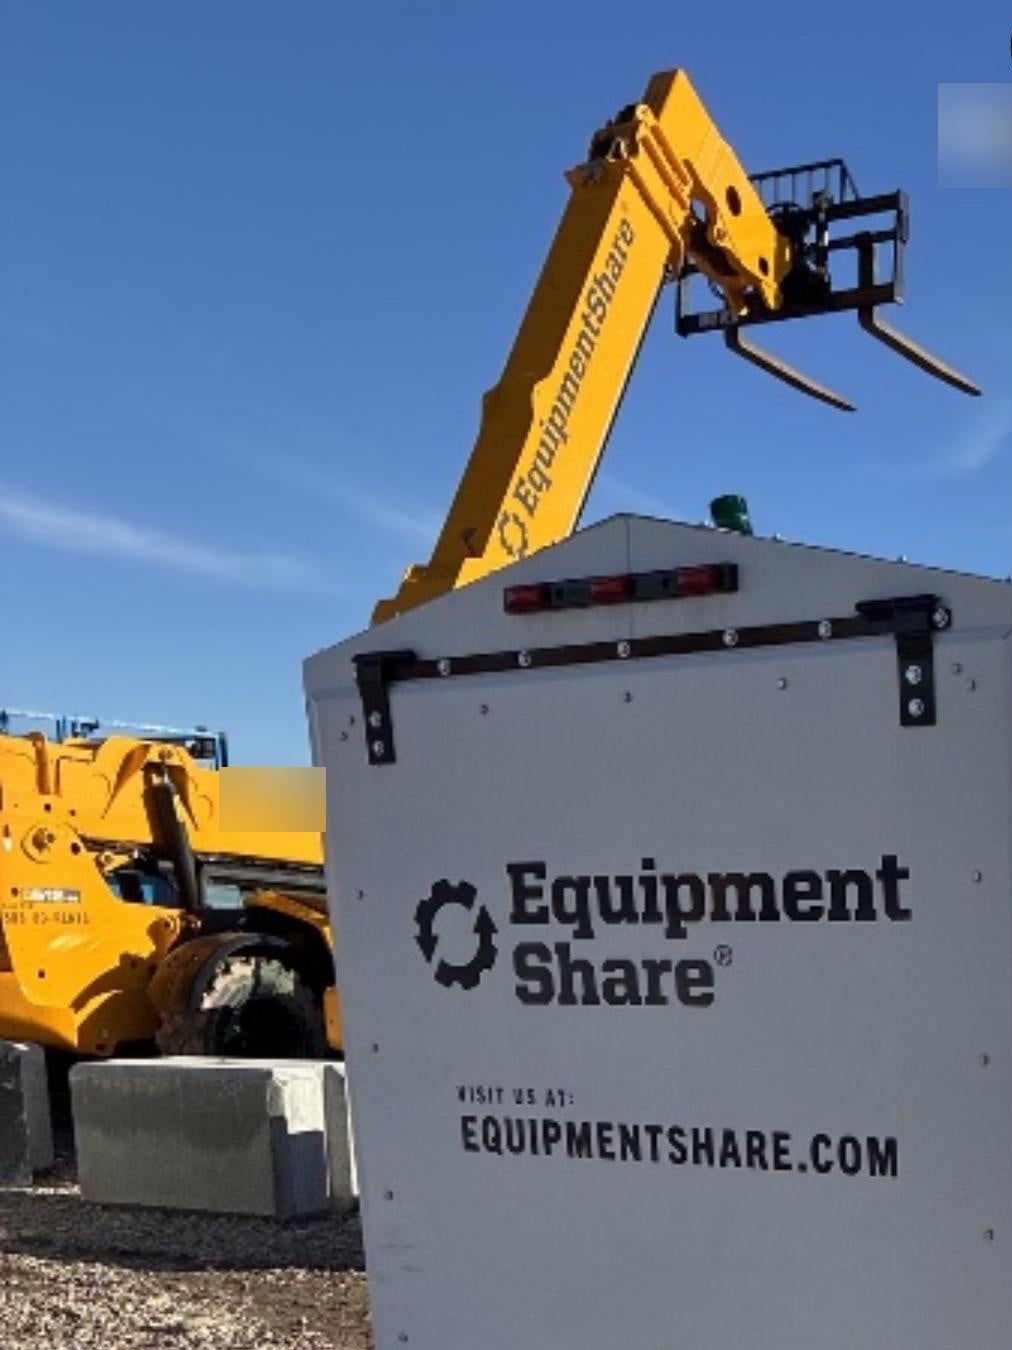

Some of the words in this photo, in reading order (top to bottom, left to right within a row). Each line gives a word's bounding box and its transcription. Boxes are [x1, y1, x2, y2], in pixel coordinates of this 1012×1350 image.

[513, 217, 635, 518] EquipmentShare
[505, 854, 912, 940] Equipment
[456, 1085, 505, 1105] VISIT
[512, 1087, 537, 1106] US
[460, 1114, 899, 1178] EQUIPMENTSHARE.COM
